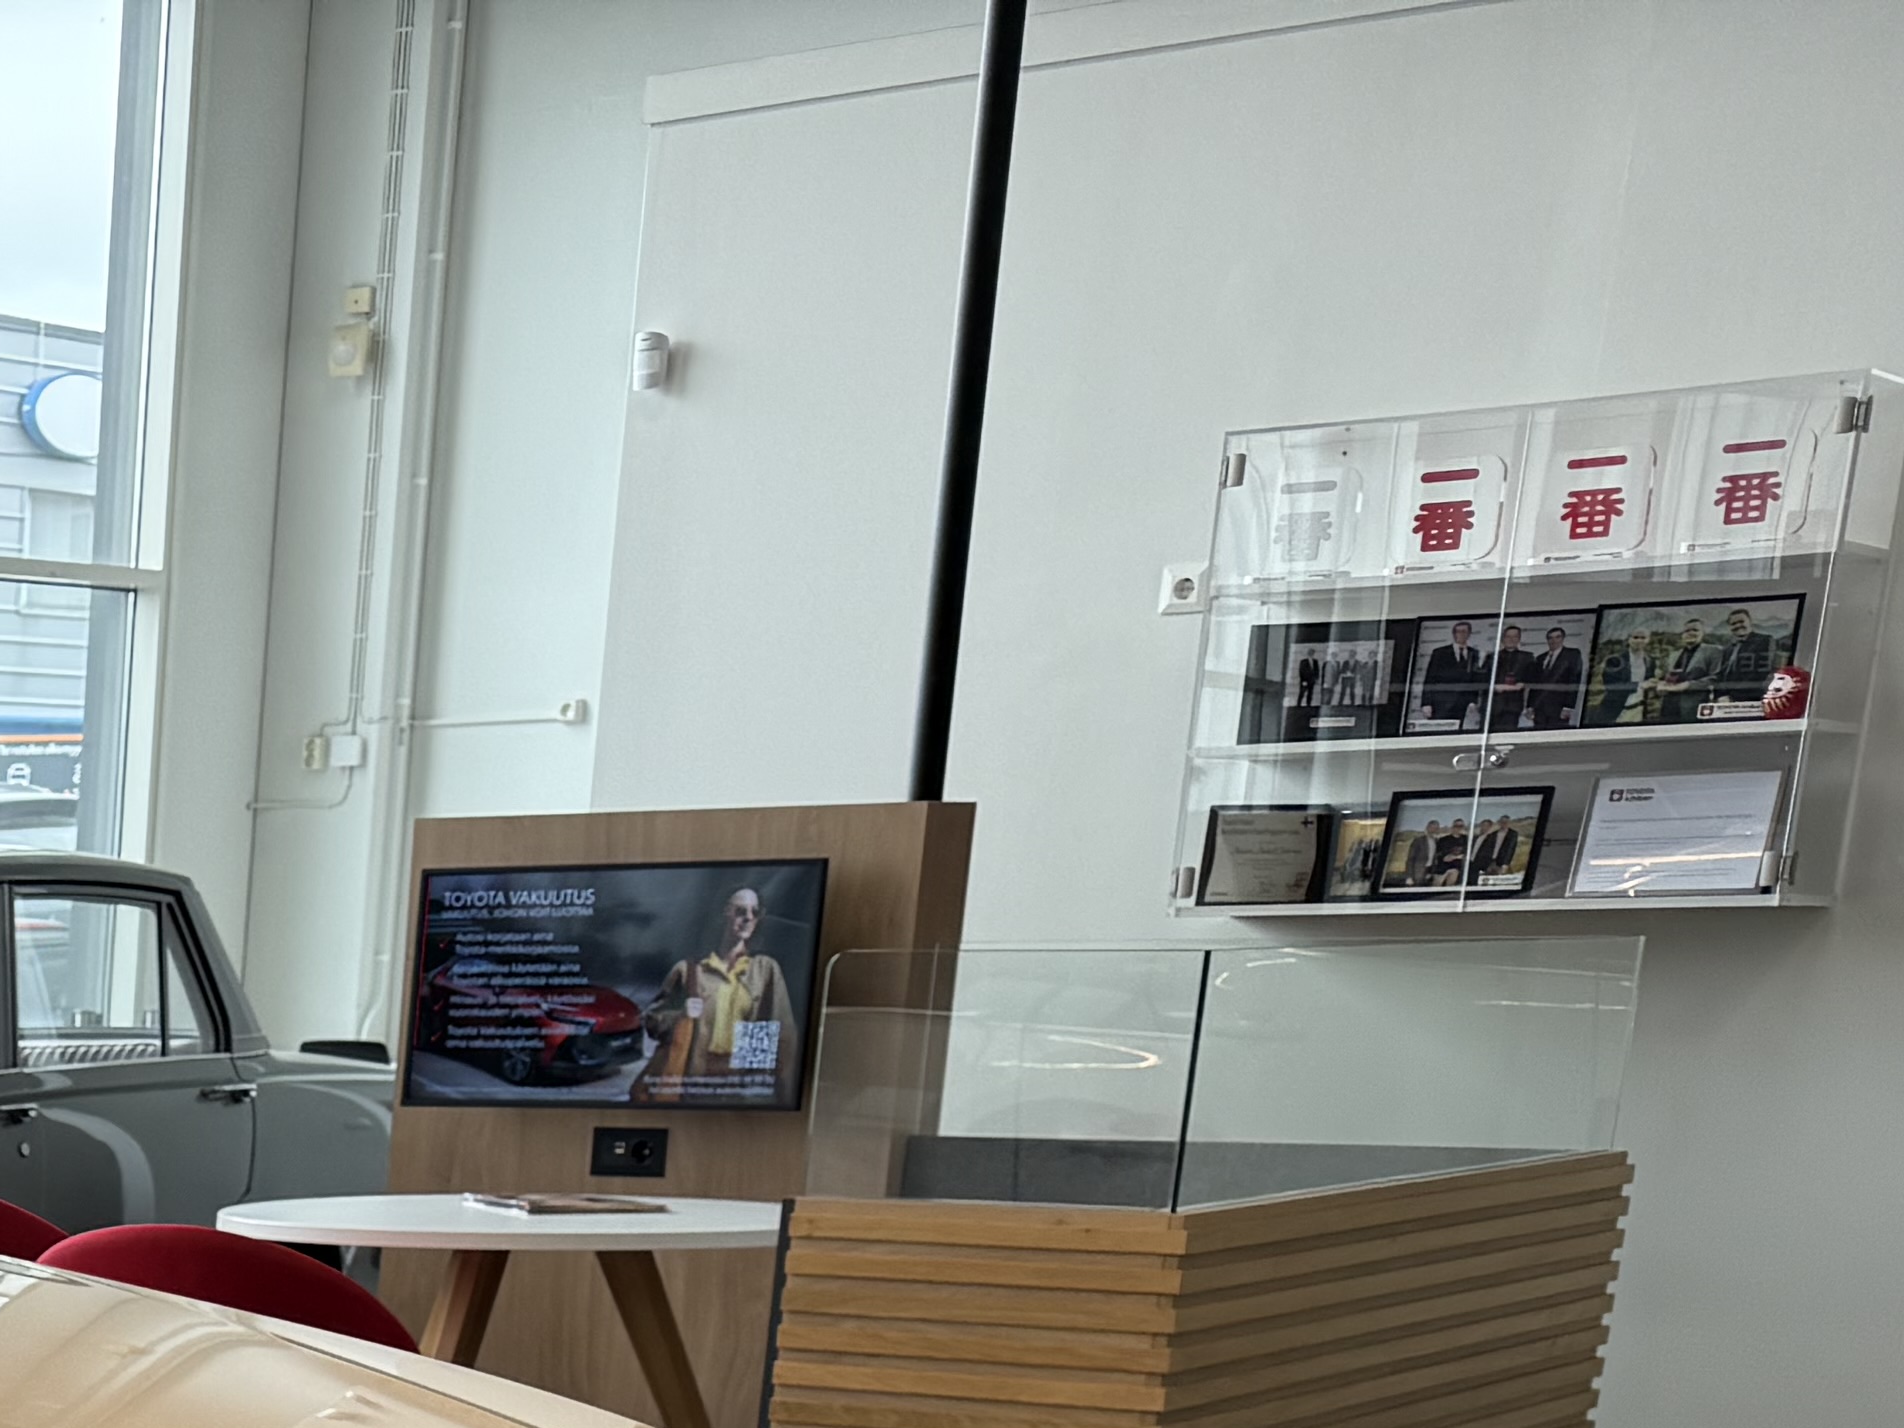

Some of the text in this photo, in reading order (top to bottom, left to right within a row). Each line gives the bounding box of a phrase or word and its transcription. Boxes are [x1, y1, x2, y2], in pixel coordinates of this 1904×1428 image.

[1412, 468, 1480, 552] 一番
[1560, 454, 1628, 540] 一番
[1714, 439, 1787, 525] 一番
[444, 888, 596, 907] TOYOTA VAKUUTUS
